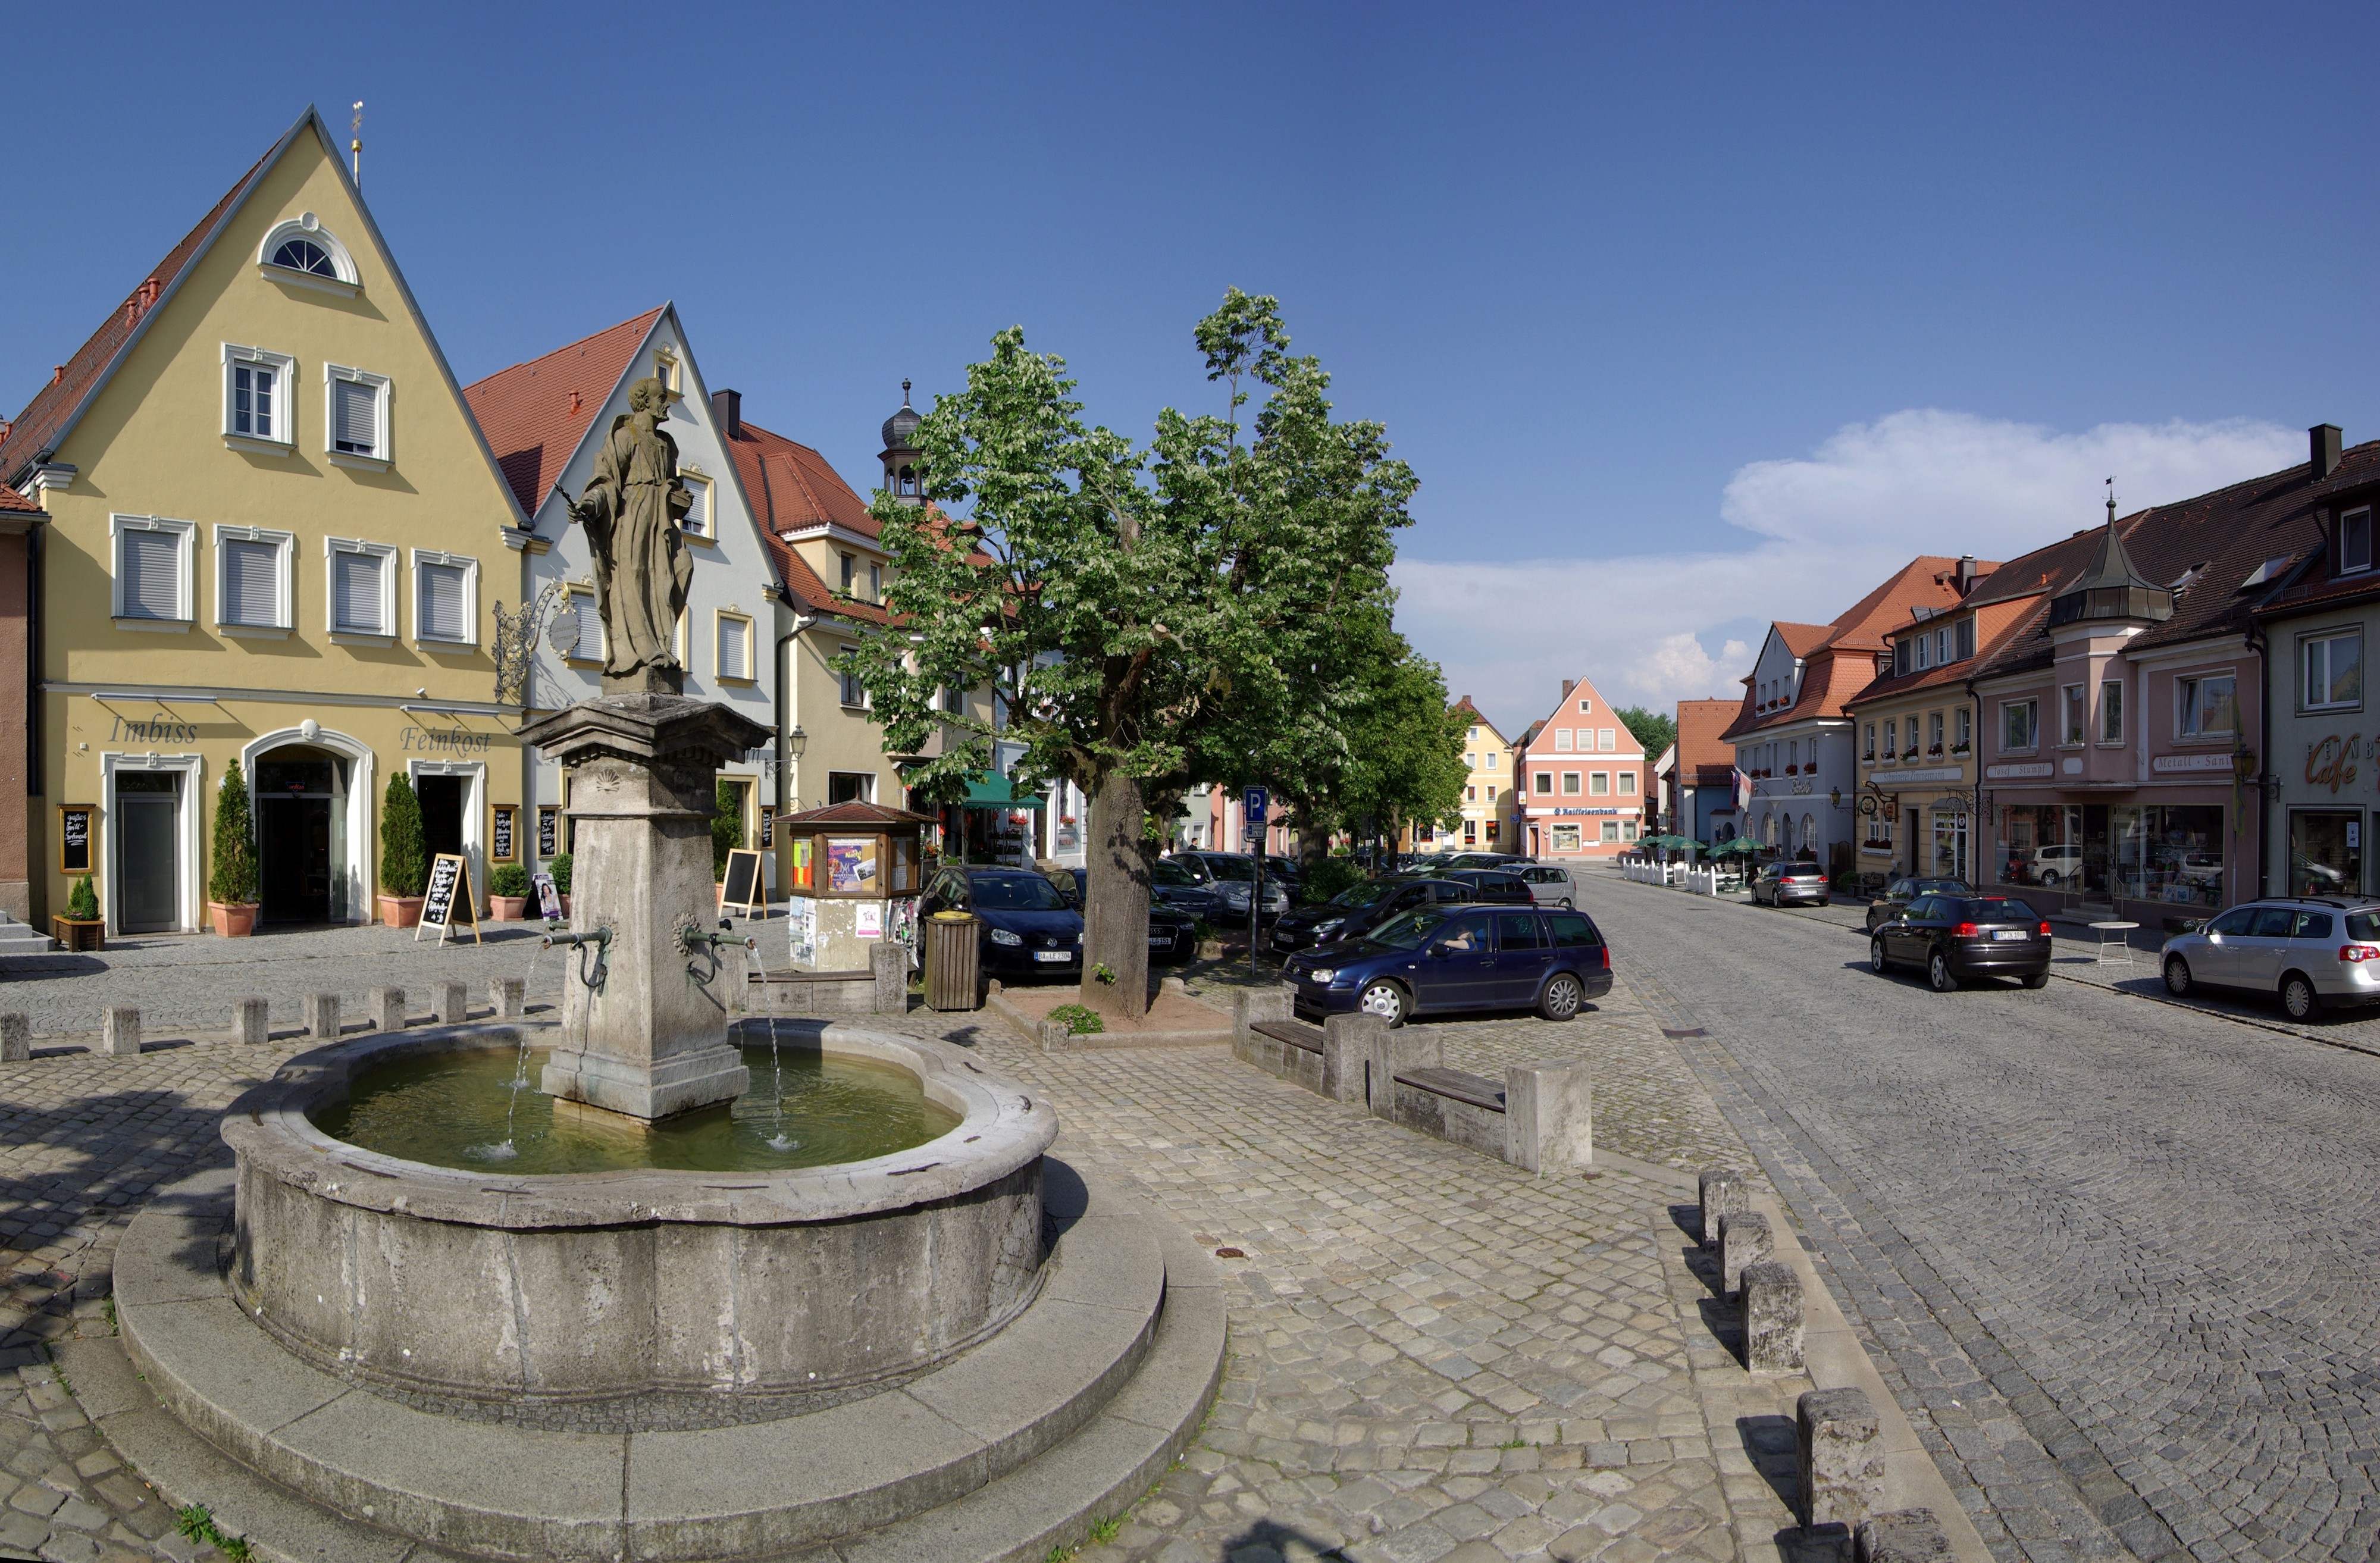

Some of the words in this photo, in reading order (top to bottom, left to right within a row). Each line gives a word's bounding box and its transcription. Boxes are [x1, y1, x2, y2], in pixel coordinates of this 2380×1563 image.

[107, 713, 197, 744] Imbiss
[400, 725, 491, 759] Feinkost
[1994, 765, 2011, 777] Josef
[2019, 763, 2046, 776] Stumpf
[2158, 756, 2191, 768] Metall
[1884, 771, 1909, 782] Schreinerei
[1910, 770, 1945, 781] Zimmermann
[1250, 793, 1261, 817] P
